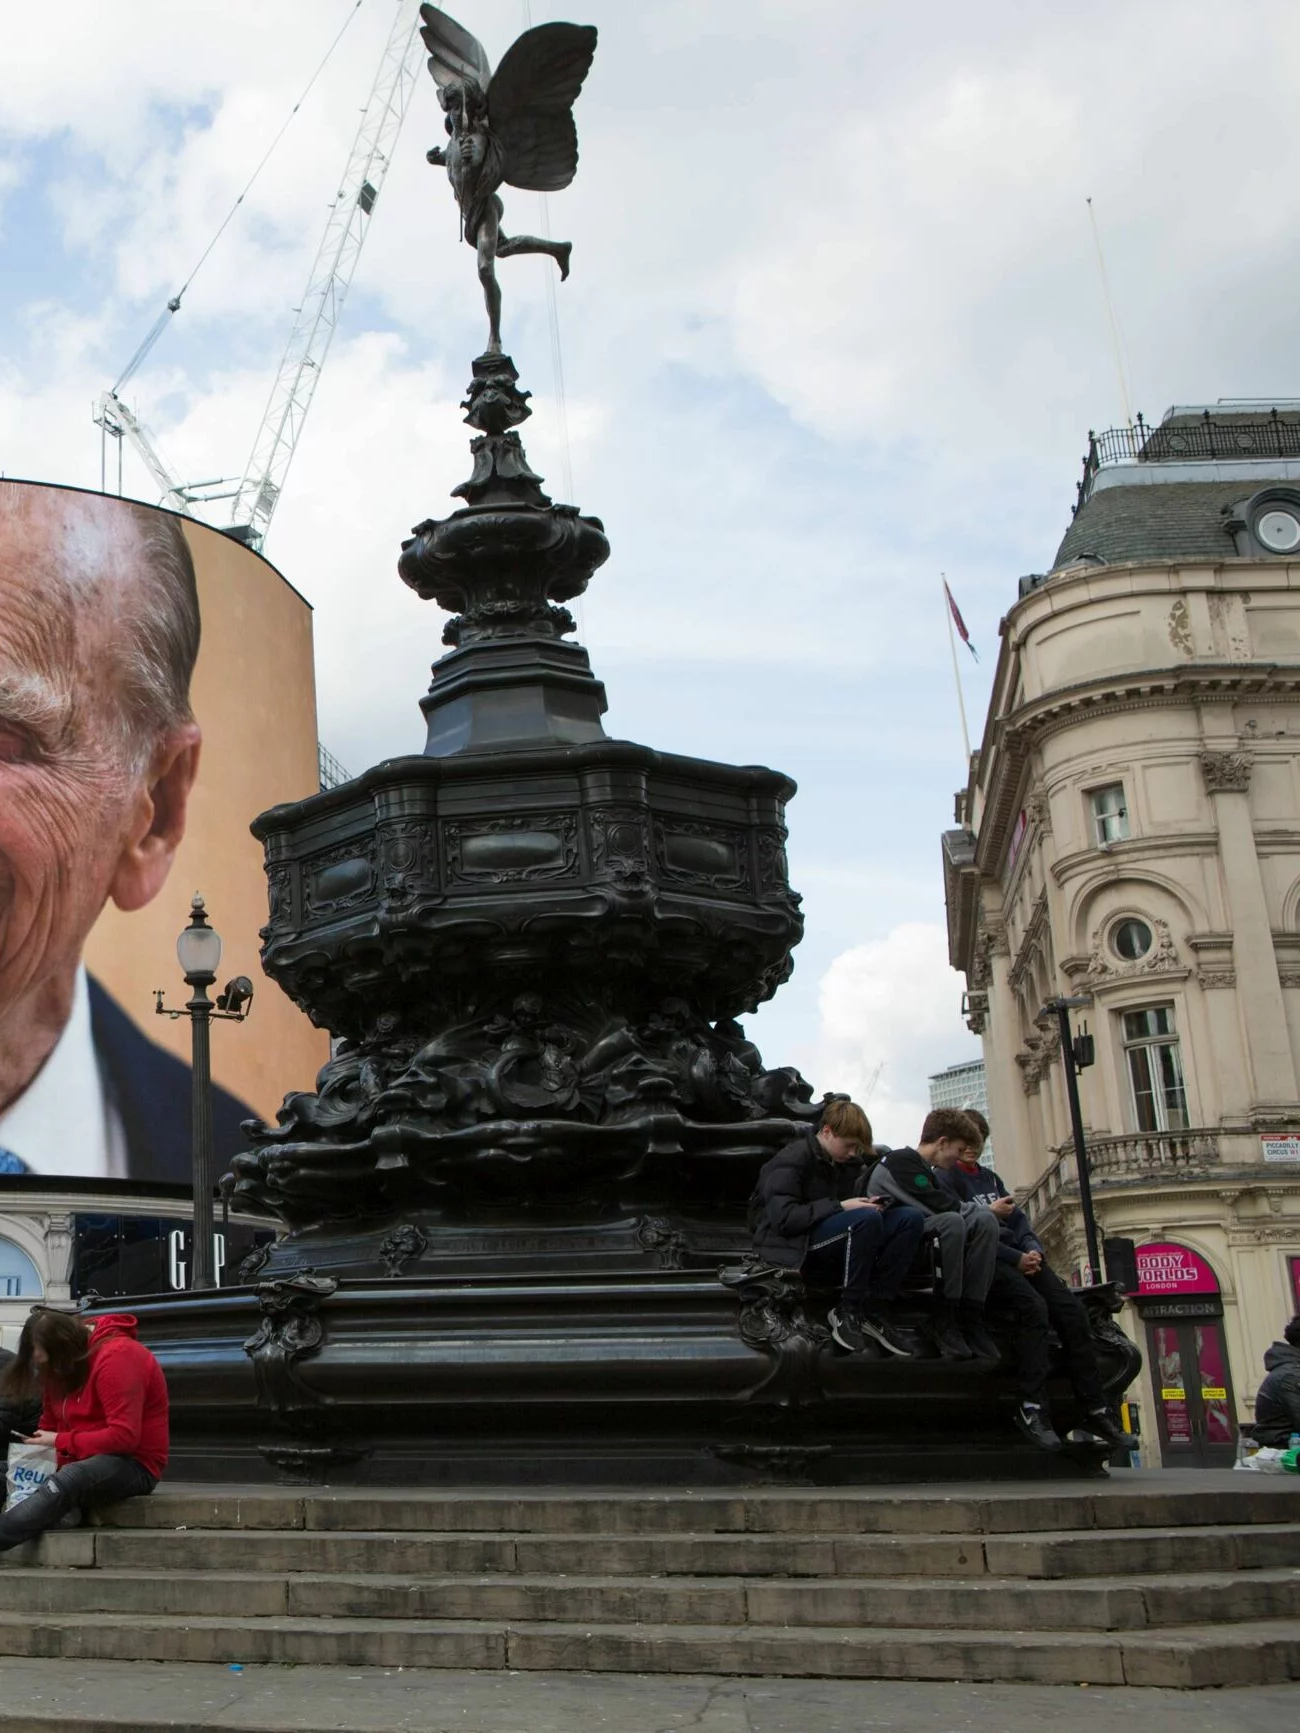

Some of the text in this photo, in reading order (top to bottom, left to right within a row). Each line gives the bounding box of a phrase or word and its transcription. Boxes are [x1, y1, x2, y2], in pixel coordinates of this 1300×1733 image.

[171, 1229, 226, 1291] GP
[1137, 1254, 1184, 1269] BODY
[1146, 1282, 1178, 1290] LONDON
[1142, 1304, 1215, 1316] ATTRACTION
